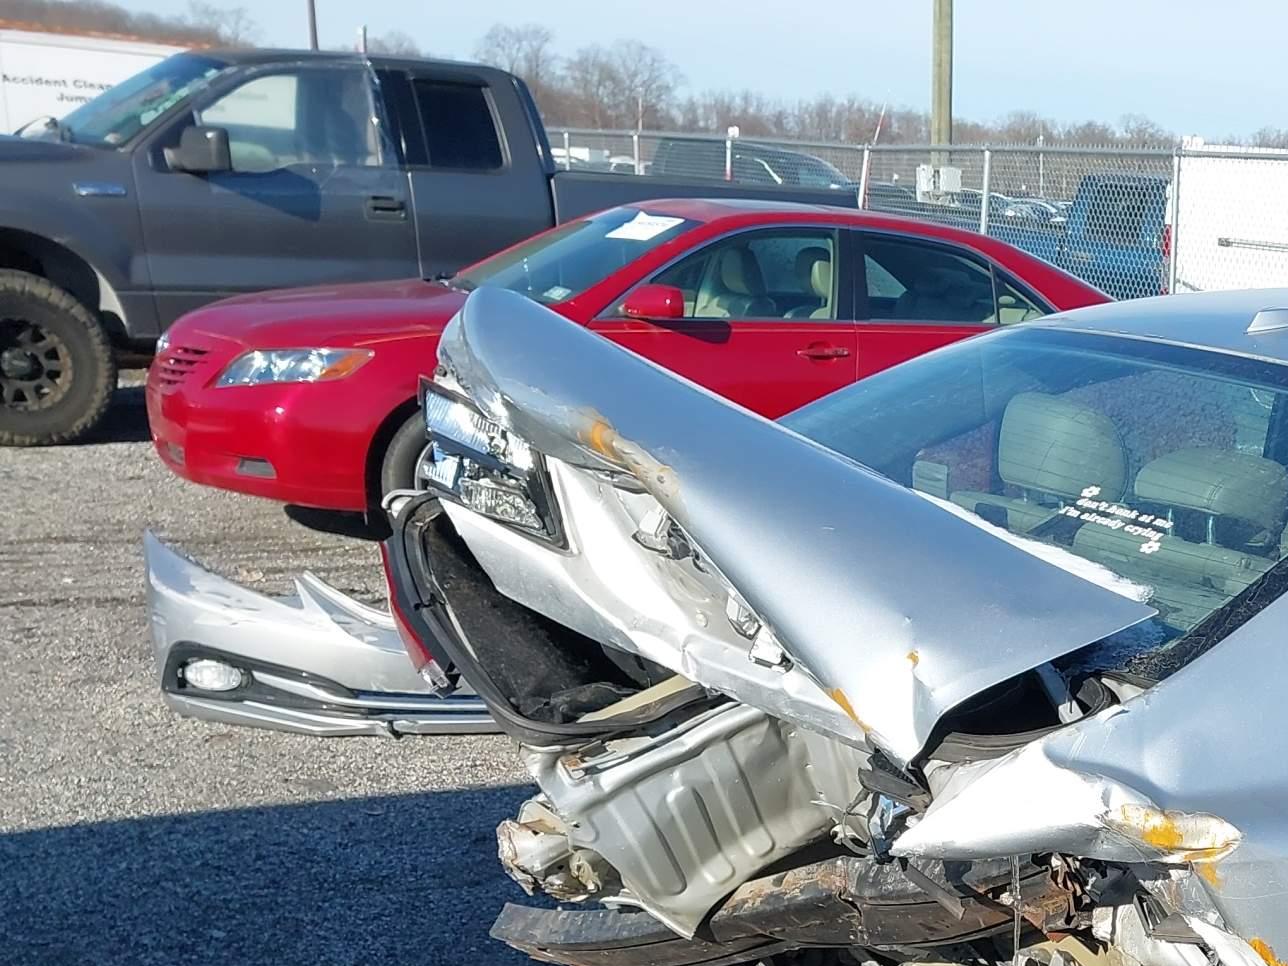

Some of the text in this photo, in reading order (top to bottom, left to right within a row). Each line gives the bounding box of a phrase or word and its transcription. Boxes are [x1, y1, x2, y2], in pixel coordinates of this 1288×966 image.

[2, 74, 67, 88] Accident
[1076, 498, 1173, 528] don't honk at me
[1080, 513, 1125, 530] already
[1124, 525, 1164, 540] crying
